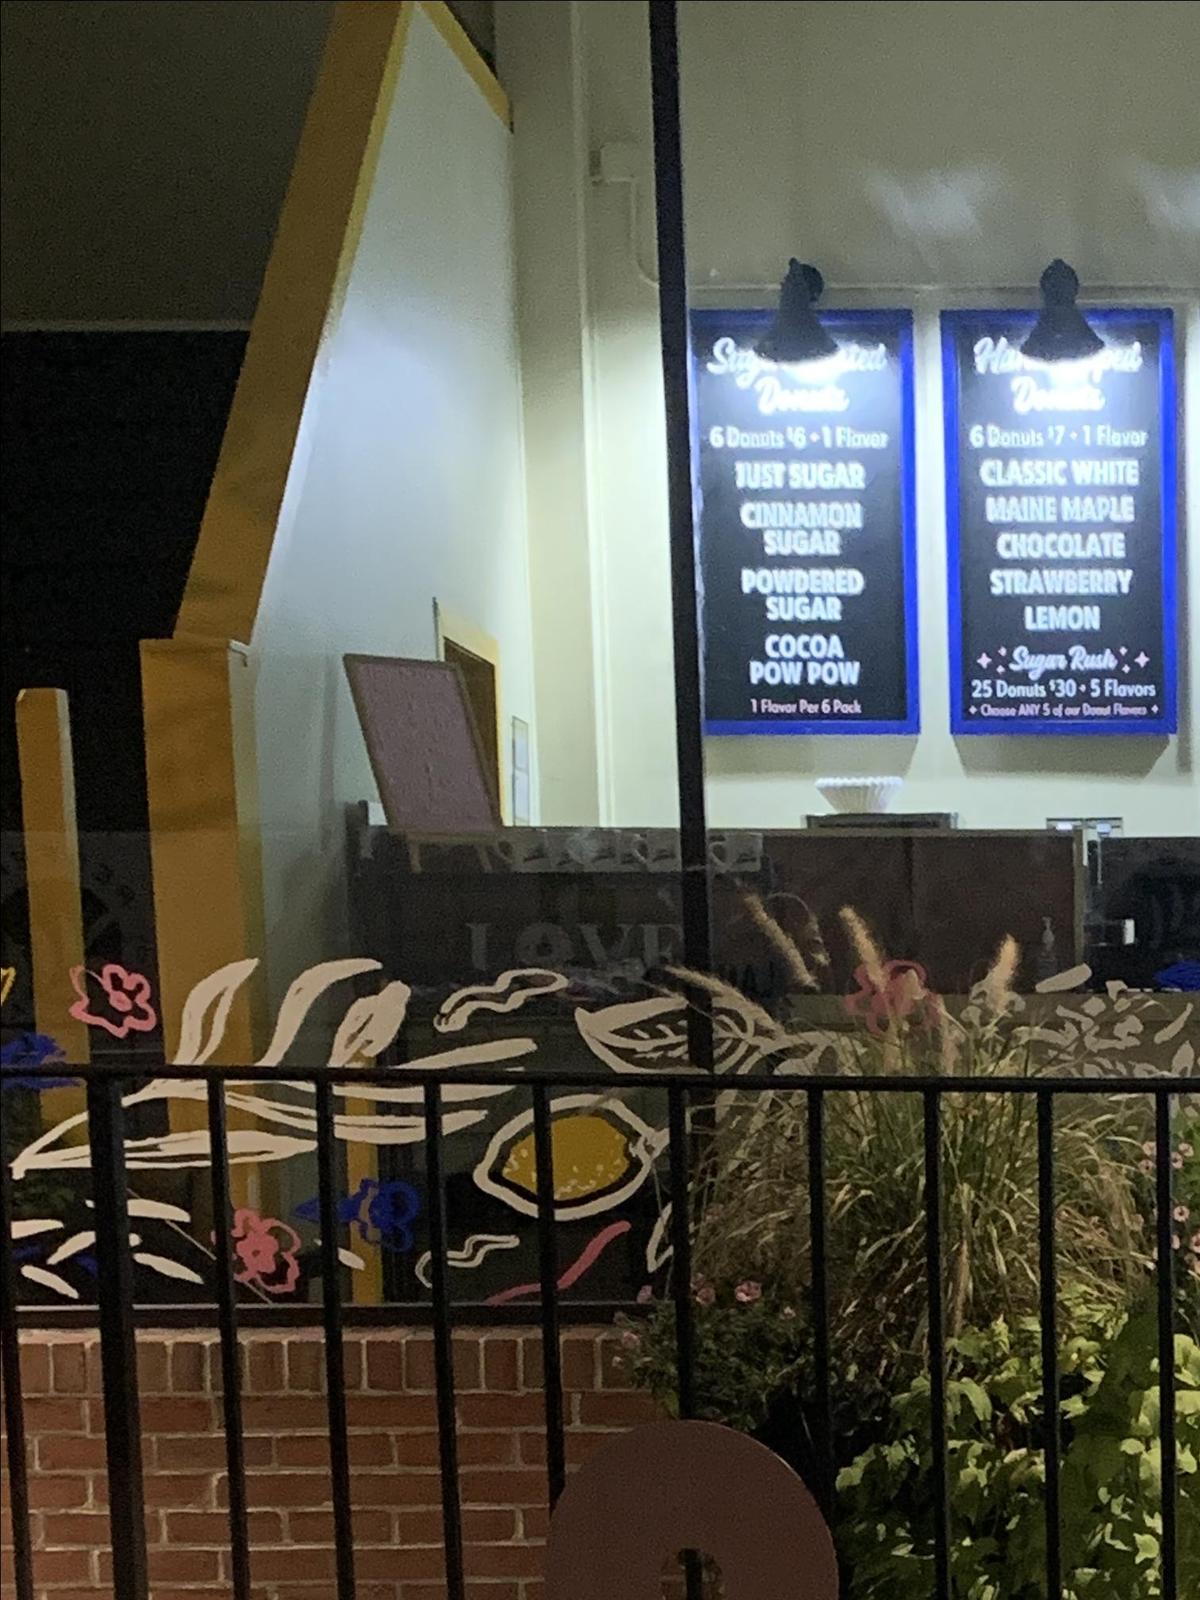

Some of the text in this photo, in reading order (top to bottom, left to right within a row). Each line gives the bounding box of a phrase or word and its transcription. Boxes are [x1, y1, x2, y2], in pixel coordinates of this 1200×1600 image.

[709, 426, 724, 448] 6
[727, 426, 784, 449] Donuts
[822, 426, 832, 448] 1
[836, 426, 889, 448] Flavor
[969, 425, 985, 448] 6
[987, 424, 1044, 448] Donuts
[1083, 426, 1091, 447] 1
[1096, 424, 1148, 447] Flavor
[735, 461, 865, 488] JUST SUGAR
[979, 459, 1139, 487] CLASSIC WHITE
[740, 502, 863, 528] CINNAMON
[985, 496, 1135, 523] MAINE MAPLE
[763, 530, 841, 556] SUGAR
[997, 532, 1126, 559] CHOCOLATE
[741, 568, 865, 595] POWDERED
[989, 568, 1133, 595] STRAWBERRY
[766, 597, 842, 620] SUGAR
[1024, 605, 1100, 630] LEMON
[765, 634, 845, 658] COCOA
[750, 661, 860, 685] POW POW
[1009, 645, 1118, 681] Sugar Rush
[971, 678, 1156, 698] 25 Donuts $30 5 Flavors
[751, 699, 862, 714] 1 Flavor Per 6 Pack
[1018, 703, 1041, 716] ANY
[1043, 703, 1050, 716] 5
[1052, 703, 1062, 717] of
[1064, 706, 1080, 716] our
[1082, 703, 1111, 716] Donut
